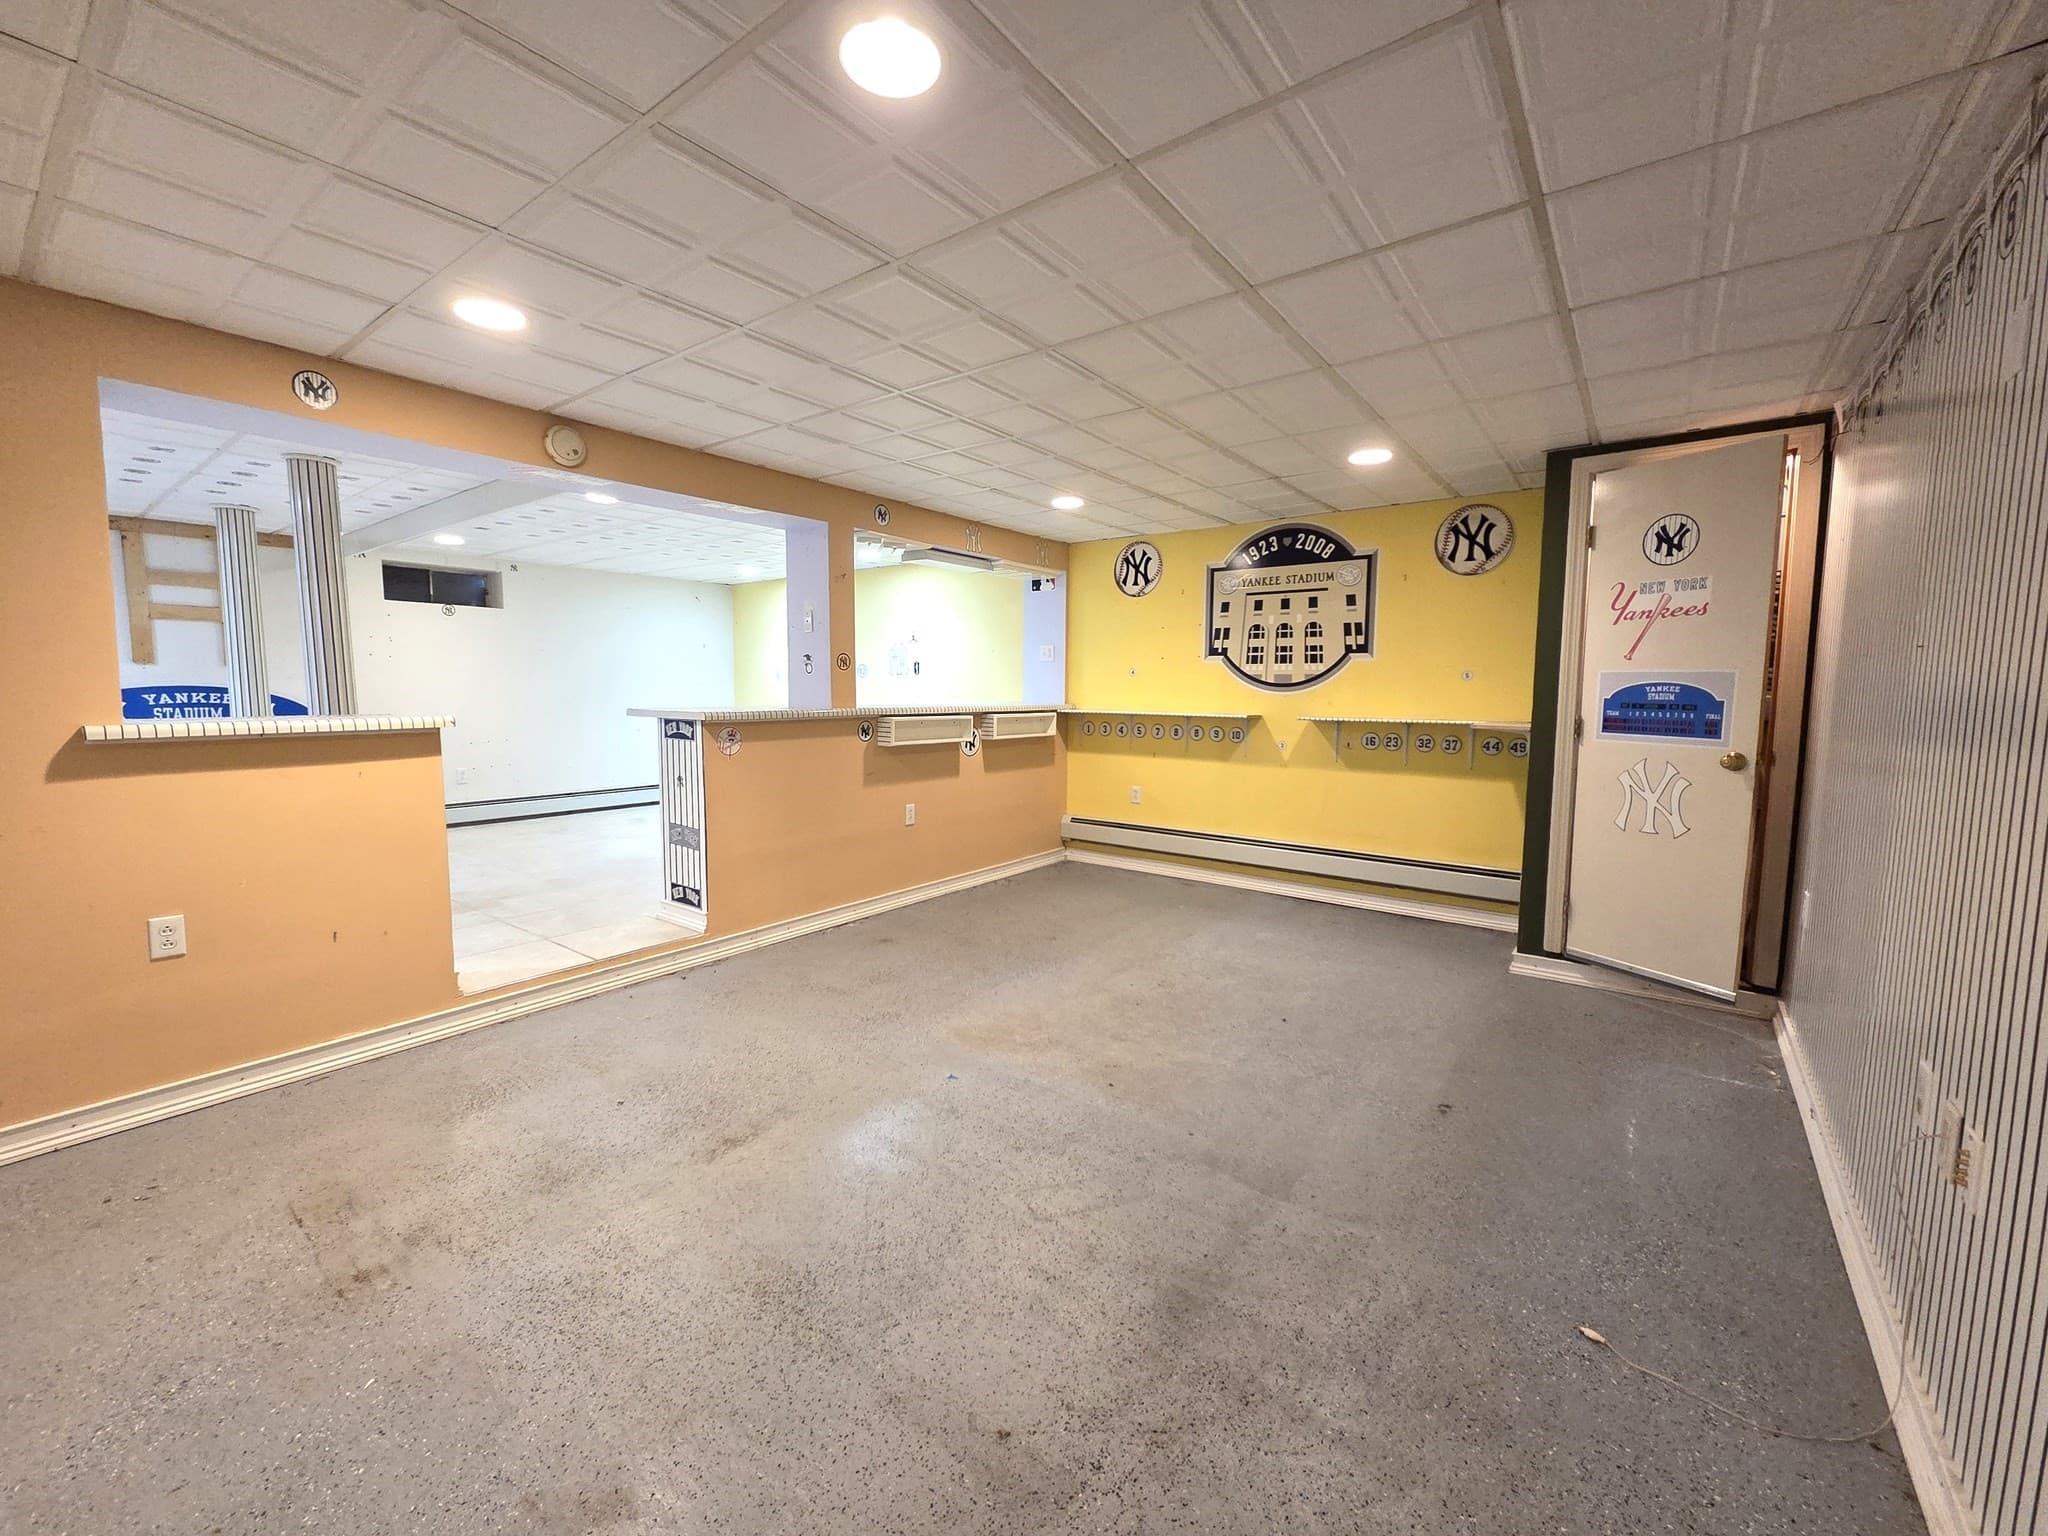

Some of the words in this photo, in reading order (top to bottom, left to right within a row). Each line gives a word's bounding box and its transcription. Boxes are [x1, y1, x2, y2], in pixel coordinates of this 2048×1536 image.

[301, 376, 330, 403] NY
[876, 508, 888, 523] NY
[1448, 513, 1497, 563] NY
[1654, 522, 1691, 558] NY
[1242, 536, 1278, 566] 1923
[1295, 533, 1336, 559] 2008
[1121, 548, 1152, 586] NY
[1240, 574, 1282, 588] YANKEE
[1286, 572, 1335, 585] STADIUM
[1640, 581, 1666, 595] NEW
[1674, 577, 1709, 592] YORK
[1610, 582, 1710, 660] Yankees
[860, 724, 871, 738] NY
[1087, 725, 1091, 733] 1
[1102, 725, 1108, 734] 3
[1118, 726, 1124, 735] 4
[1137, 726, 1142, 735] 5
[1155, 728, 1161, 736] 7
[1174, 728, 1179, 736] 8
[1214, 730, 1219, 738] 9
[1232, 730, 1240, 740] 10
[1365, 736, 1376, 746] 16
[1386, 737, 1398, 747] 23
[1418, 738, 1432, 748] 32
[1444, 740, 1458, 750] 37
[1482, 741, 1500, 751] 44
[1510, 742, 1526, 752] 49
[1614, 757, 1692, 840] NY
